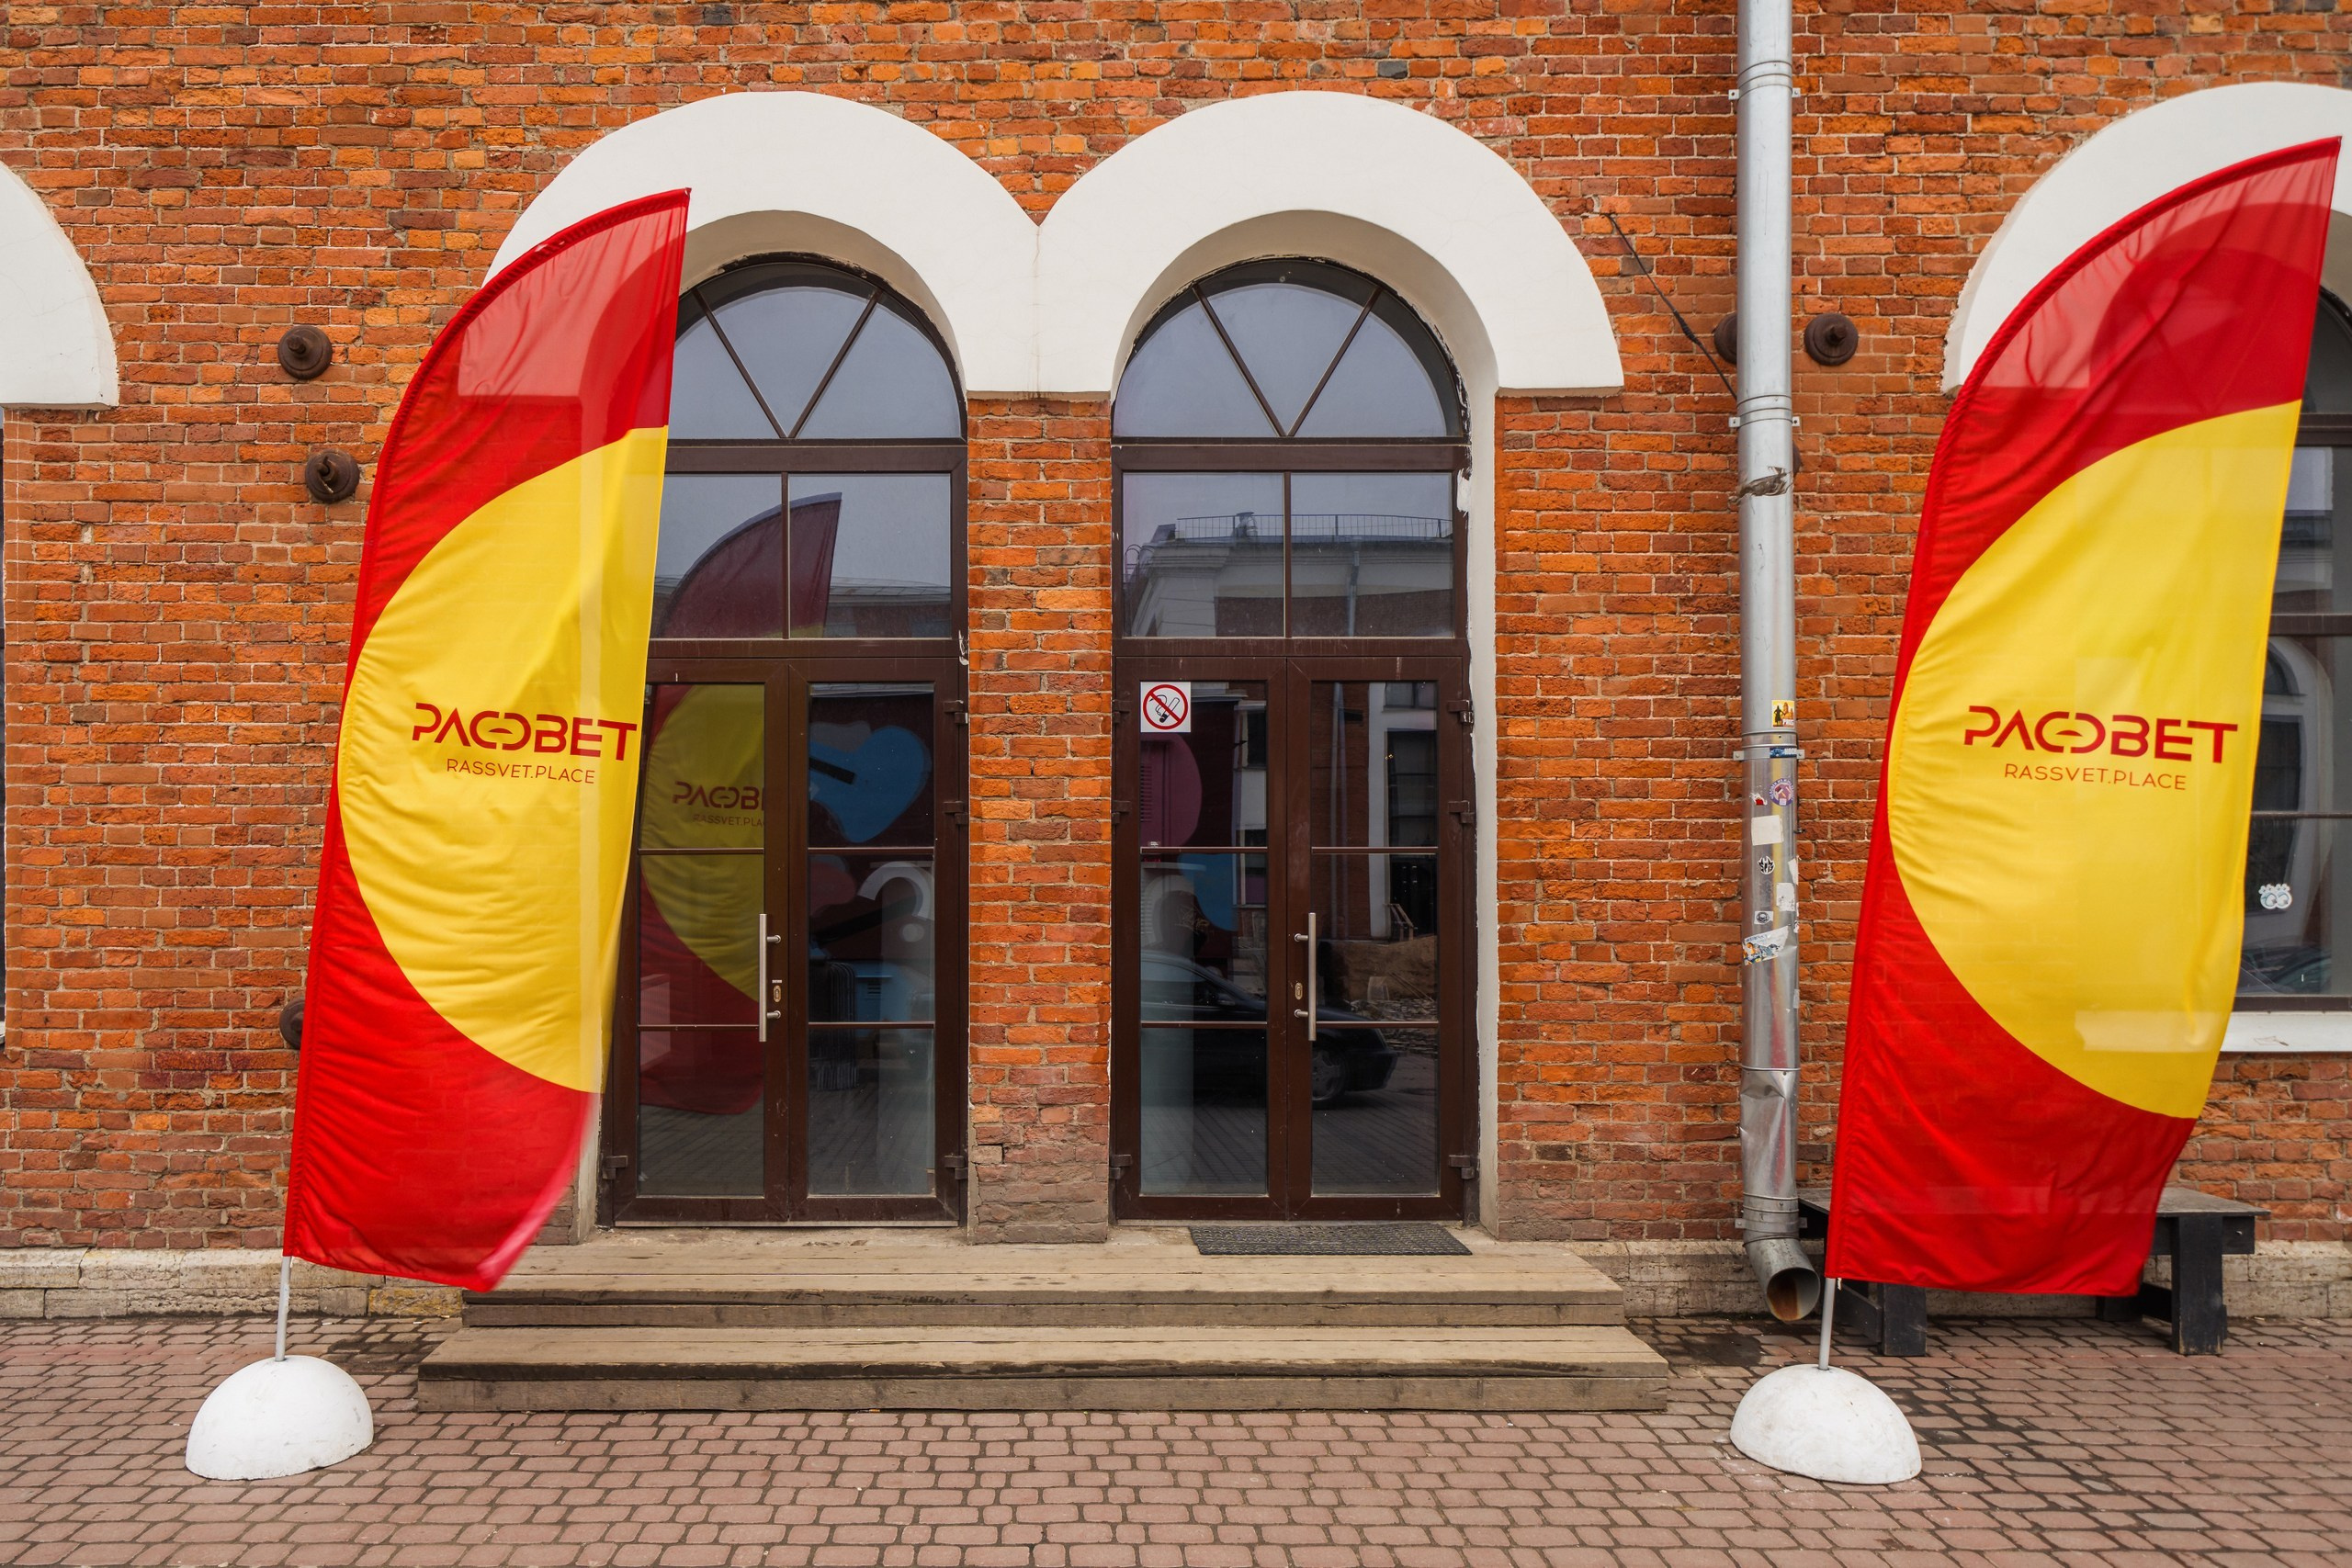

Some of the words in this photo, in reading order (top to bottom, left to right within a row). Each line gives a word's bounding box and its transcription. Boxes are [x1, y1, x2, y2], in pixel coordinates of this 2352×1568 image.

[447, 758, 596, 784] RASSVET.PLACE
[2004, 763, 2188, 791] RASSVET.PLACE
[692, 813, 764, 828] RASSVET.PLA
